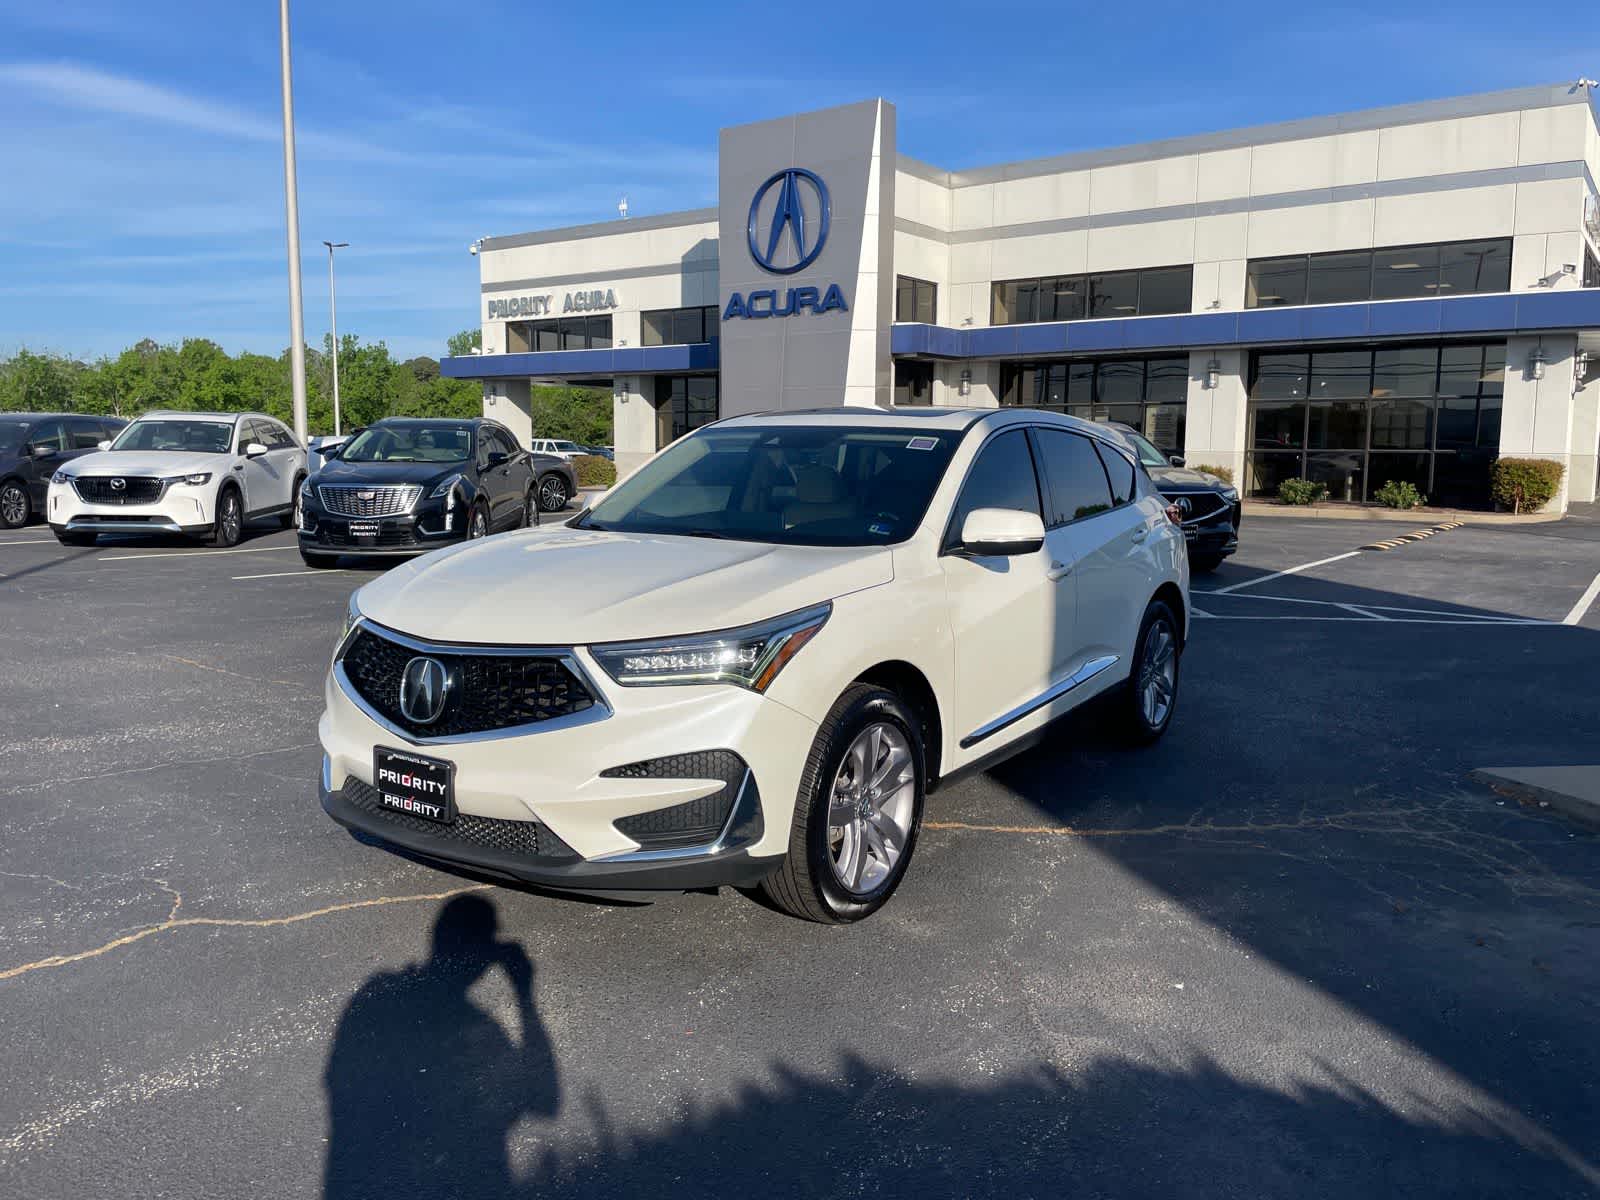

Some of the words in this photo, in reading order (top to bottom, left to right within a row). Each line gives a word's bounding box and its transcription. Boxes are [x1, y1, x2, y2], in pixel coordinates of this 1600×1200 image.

[487, 294, 553, 319] PRIORITY
[562, 288, 618, 314] ACURA
[722, 283, 849, 321] ACURA
[379, 768, 447, 796] PRIORITY
[384, 794, 440, 818] PRIORITY
